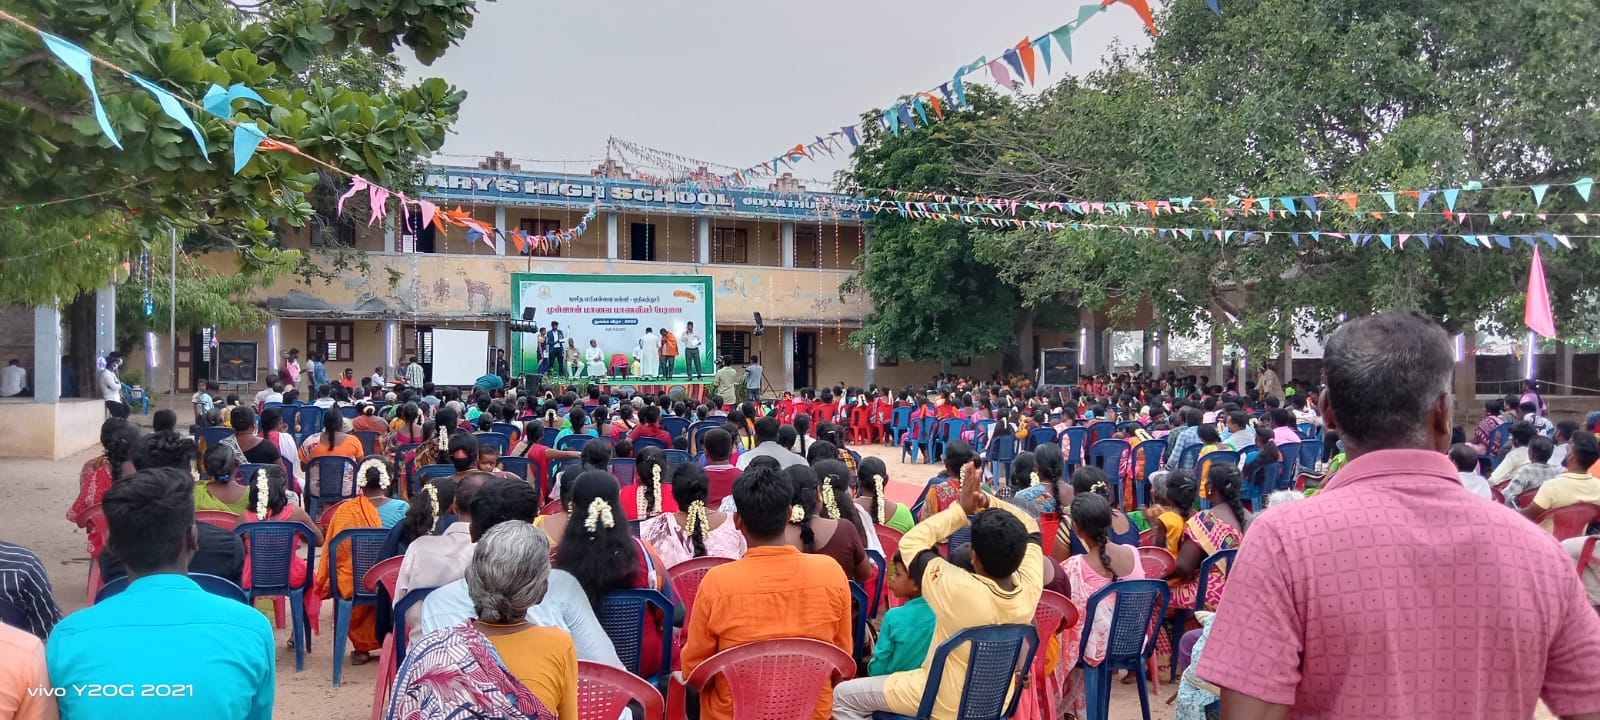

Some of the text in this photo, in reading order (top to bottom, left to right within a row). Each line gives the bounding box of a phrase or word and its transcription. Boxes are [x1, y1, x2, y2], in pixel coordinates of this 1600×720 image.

[525, 180, 606, 199] HIGH
[611, 186, 732, 206] SCHOOL
[546, 305, 582, 314] முன்னாள்
[614, 305, 652, 313] மாணவியர்
